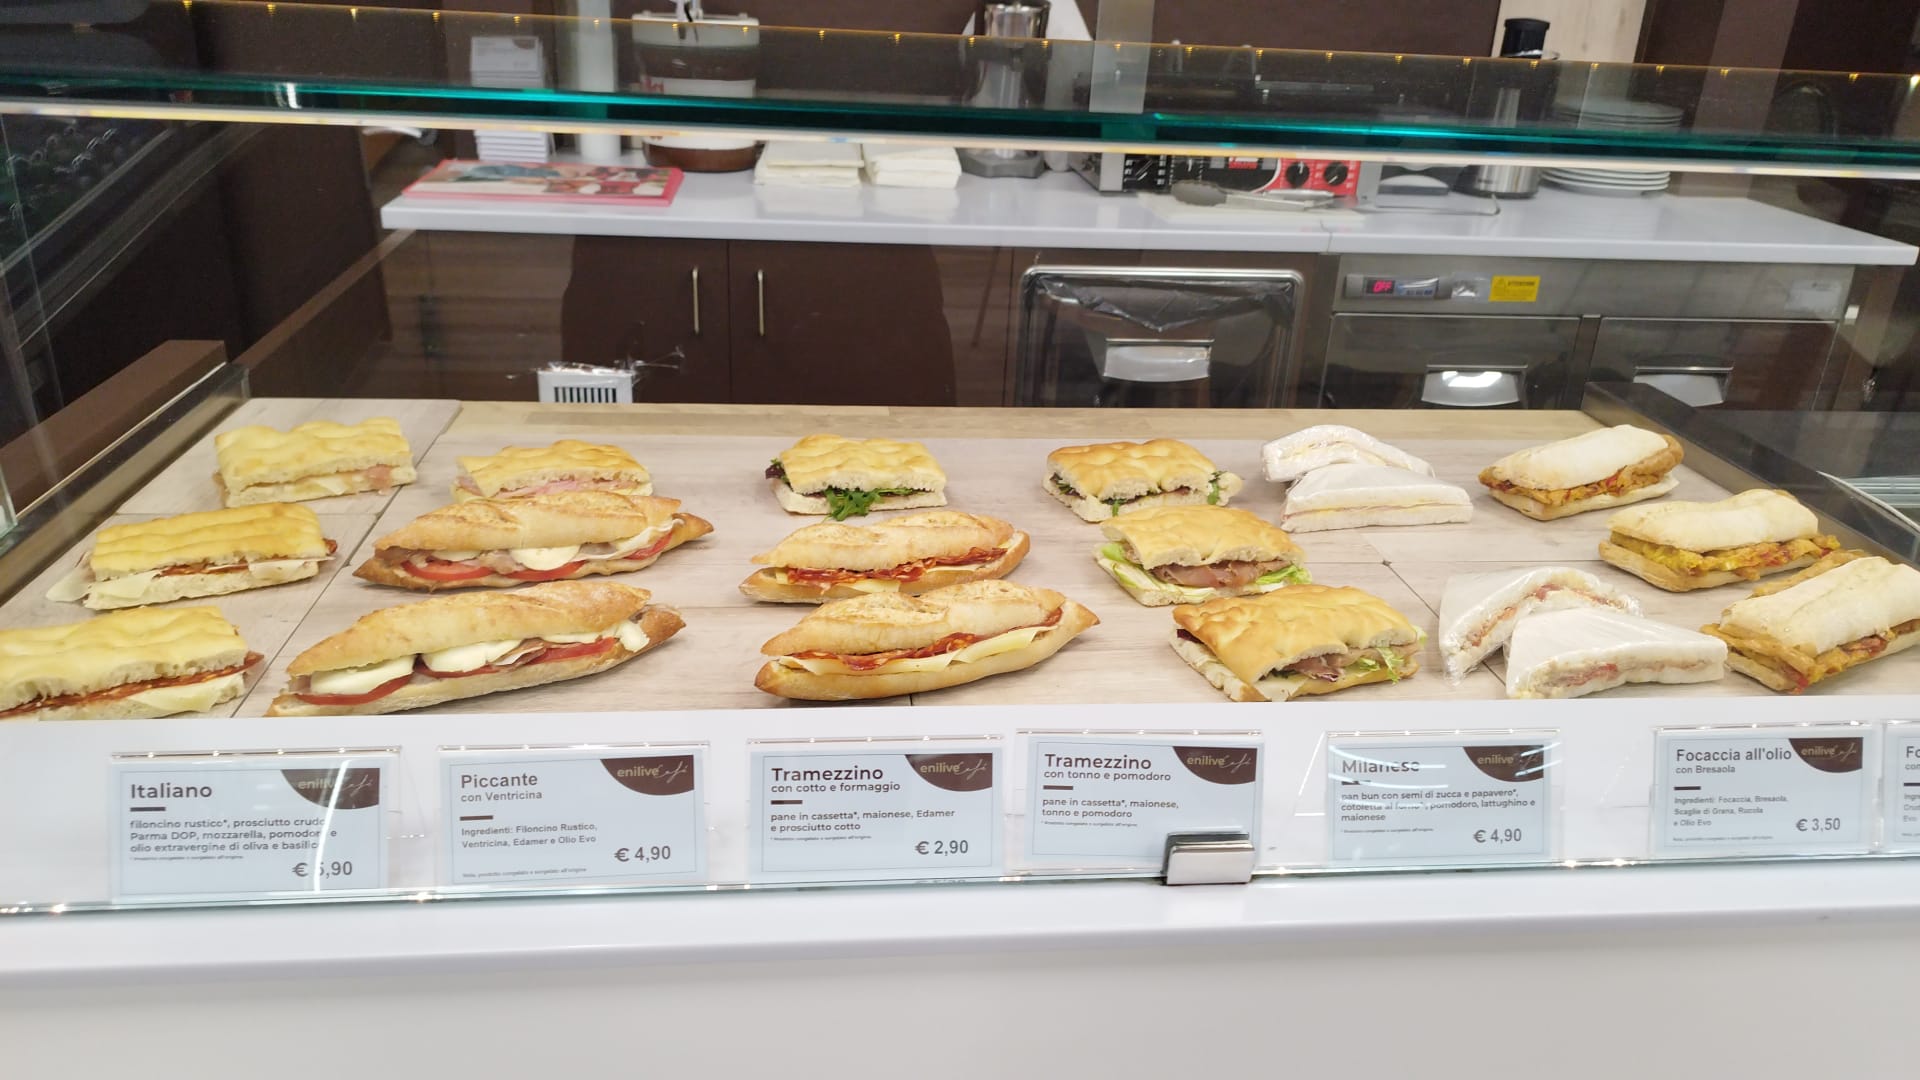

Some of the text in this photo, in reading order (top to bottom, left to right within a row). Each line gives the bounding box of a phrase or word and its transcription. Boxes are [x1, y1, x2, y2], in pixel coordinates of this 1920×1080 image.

[1372, 281, 1392, 294] OFF
[1676, 748, 1791, 761] Focaccia all'olio
[1801, 746, 1836, 756] enilive
[1045, 754, 1151, 769] Tramezzino
[1187, 756, 1225, 766] enilive
[1477, 755, 1514, 765] enilive
[617, 766, 659, 778] enilive
[772, 766, 883, 781] Tramezzino
[920, 762, 960, 773] enilive
[1696, 765, 1735, 773] Bresaola
[461, 773, 537, 788] Piccante
[1067, 770, 1100, 779] tonno
[1113, 772, 1171, 782] pomodoro
[298, 776, 342, 790] eniliv
[796, 783, 826, 792] cotto
[840, 781, 900, 793] formaggio
[131, 782, 212, 799] Italiano
[461, 791, 542, 802] con Ventricina
[1401, 790, 1422, 799] semi
[1425, 790, 1433, 798] di
[1043, 799, 1066, 807] pane
[1070, 798, 1078, 806] in
[1130, 800, 1179, 809] maionese,
[1481, 799, 1527, 808] lattughino
[771, 813, 796, 822] pane
[799, 812, 808, 820] in
[863, 810, 914, 819] maionese,
[917, 809, 955, 817] Edamer
[1082, 809, 1132, 818] pomodoro
[1341, 813, 1385, 821] maionese
[130, 819, 181, 829] filoncino
[234, 816, 290, 828] prosciutto
[780, 823, 831, 833] prosciutto
[1796, 818, 1841, 832] € 3,50
[131, 831, 167, 840] Parma
[171, 830, 199, 841] DOP,
[203, 828, 265, 840] mozzarella,
[462, 823, 597, 836] Ingredienti: Filoncino Rustico,
[462, 838, 511, 848] Ventricina,
[514, 837, 548, 845] Edamer
[559, 835, 576, 843] Olio
[1473, 829, 1521, 844] € 4,90
[131, 843, 151, 852] olio
[155, 843, 225, 853] extravergine
[229, 842, 240, 850] di
[244, 841, 269, 850] oliva
[915, 840, 968, 856] € 2,90
[614, 846, 671, 863] € 4,90
[292, 862, 308, 877] €
